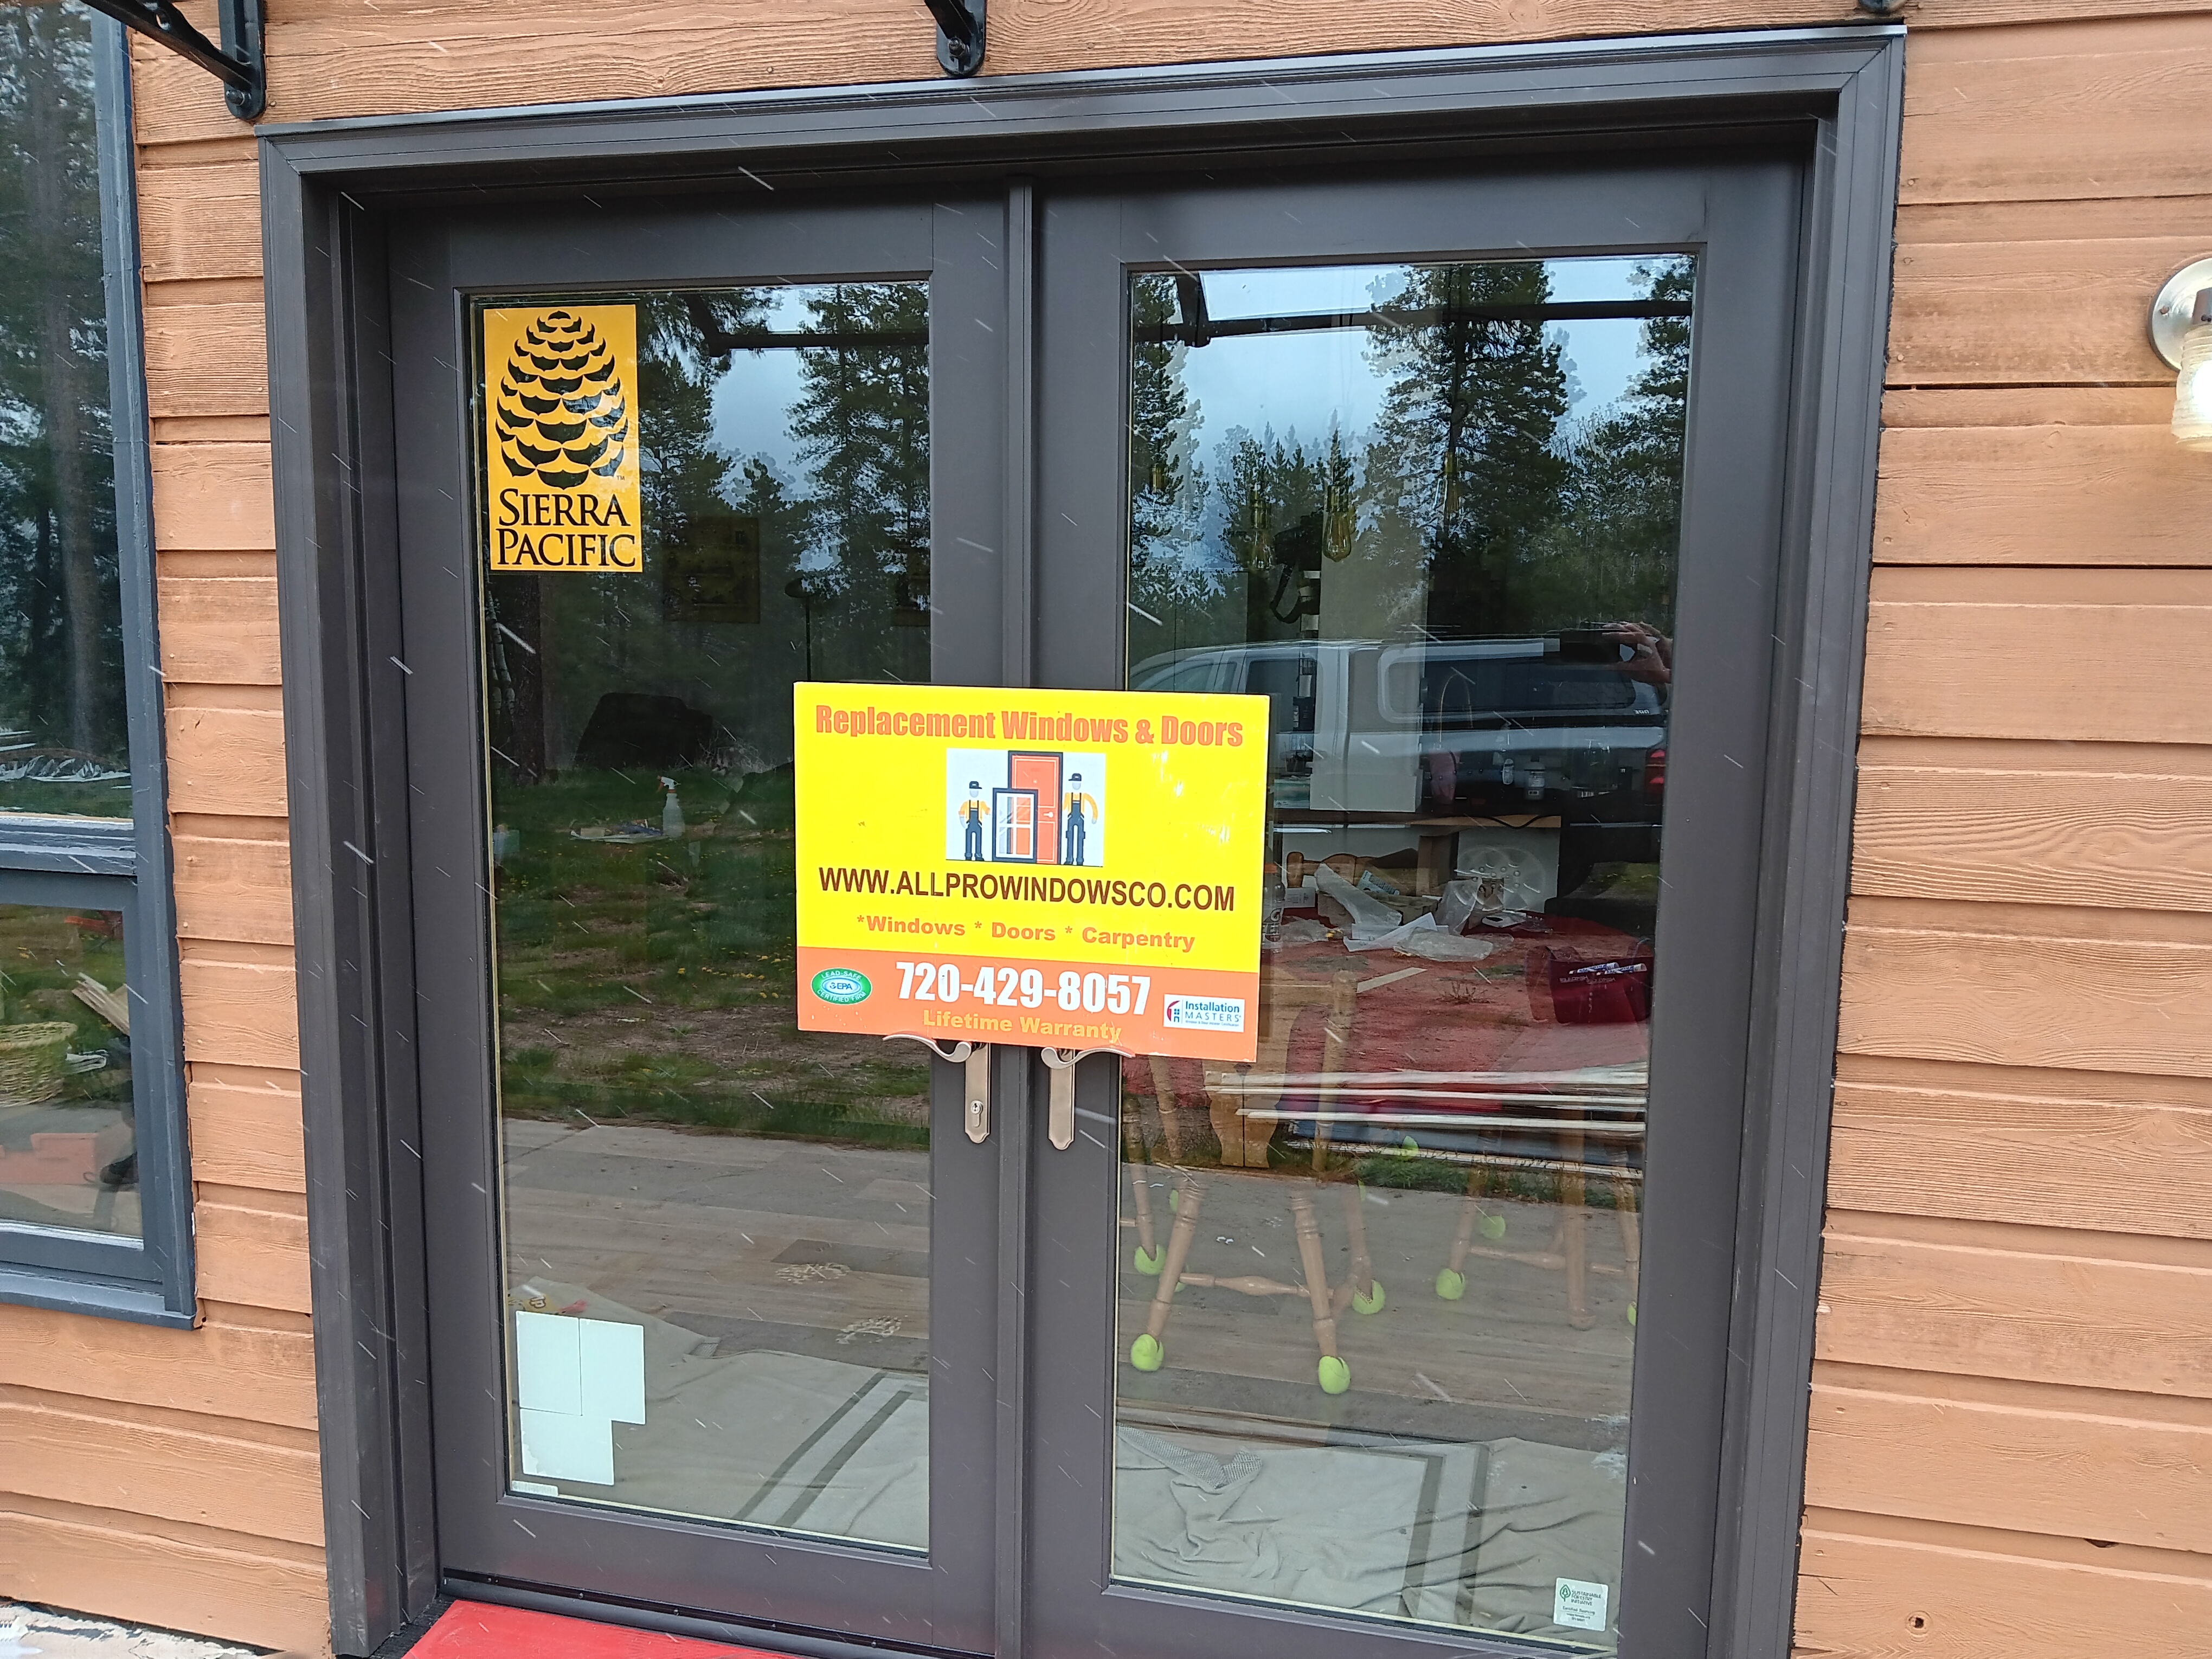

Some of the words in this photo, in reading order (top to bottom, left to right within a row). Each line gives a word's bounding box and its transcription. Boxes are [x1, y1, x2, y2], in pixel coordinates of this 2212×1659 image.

[496, 528, 635, 567] PACIFIC
[816, 705, 996, 739] Replacement
[1001, 710, 1129, 743] Windows
[1135, 719, 1154, 744] &
[1161, 715, 1243, 747] Doors
[819, 867, 1235, 912] WWW.ALLPROWINDOWSCO.COM
[992, 922, 1056, 941] Doors
[1082, 927, 1195, 953] Carpentry
[821, 970, 862, 981] LEAD-SAFE
[896, 962, 1150, 1015] 720-429-8057
[817, 989, 850, 1002] CERTIFIED
[851, 991, 866, 1001] FIRM
[1186, 1001, 1239, 1013] Installation
[923, 1009, 1012, 1031] Lifetime
[1020, 1017, 1123, 1044] Warranty
[1572, 1590, 1601, 1599] SUSTAINABLE
